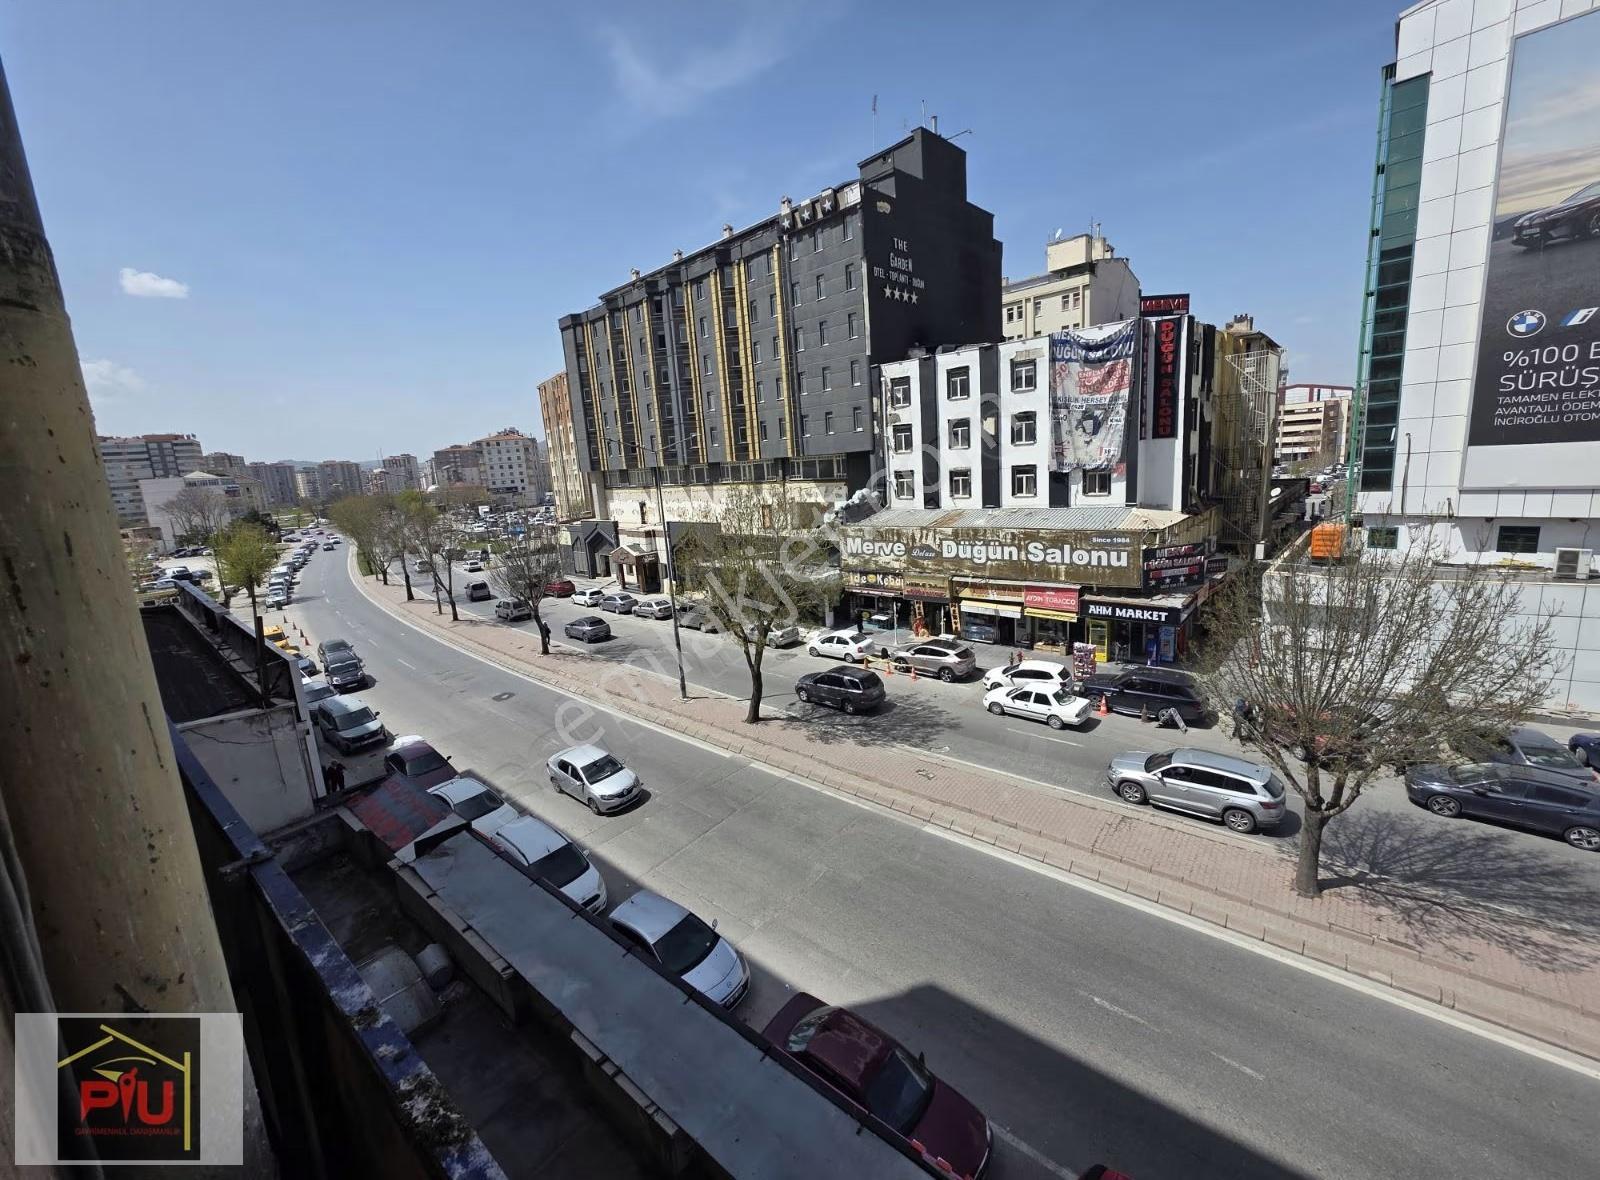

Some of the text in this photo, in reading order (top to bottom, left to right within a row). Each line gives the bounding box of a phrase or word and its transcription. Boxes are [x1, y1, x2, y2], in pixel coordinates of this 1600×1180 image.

[893, 238, 908, 252] THE
[890, 252, 913, 272] GARDEN
[873, 266, 886, 279] OTEL
[1503, 344, 1579, 367] %100
[1499, 365, 1600, 391] SÜRÜŞ
[1497, 389, 1600, 405] TAMAMEN ELEK
[1495, 405, 1559, 415] AVANTAJLI
[846, 537, 906, 557] Merve
[942, 540, 1128, 567] Düğün Salonu
[1089, 604, 1168, 621] AHM MARKET
